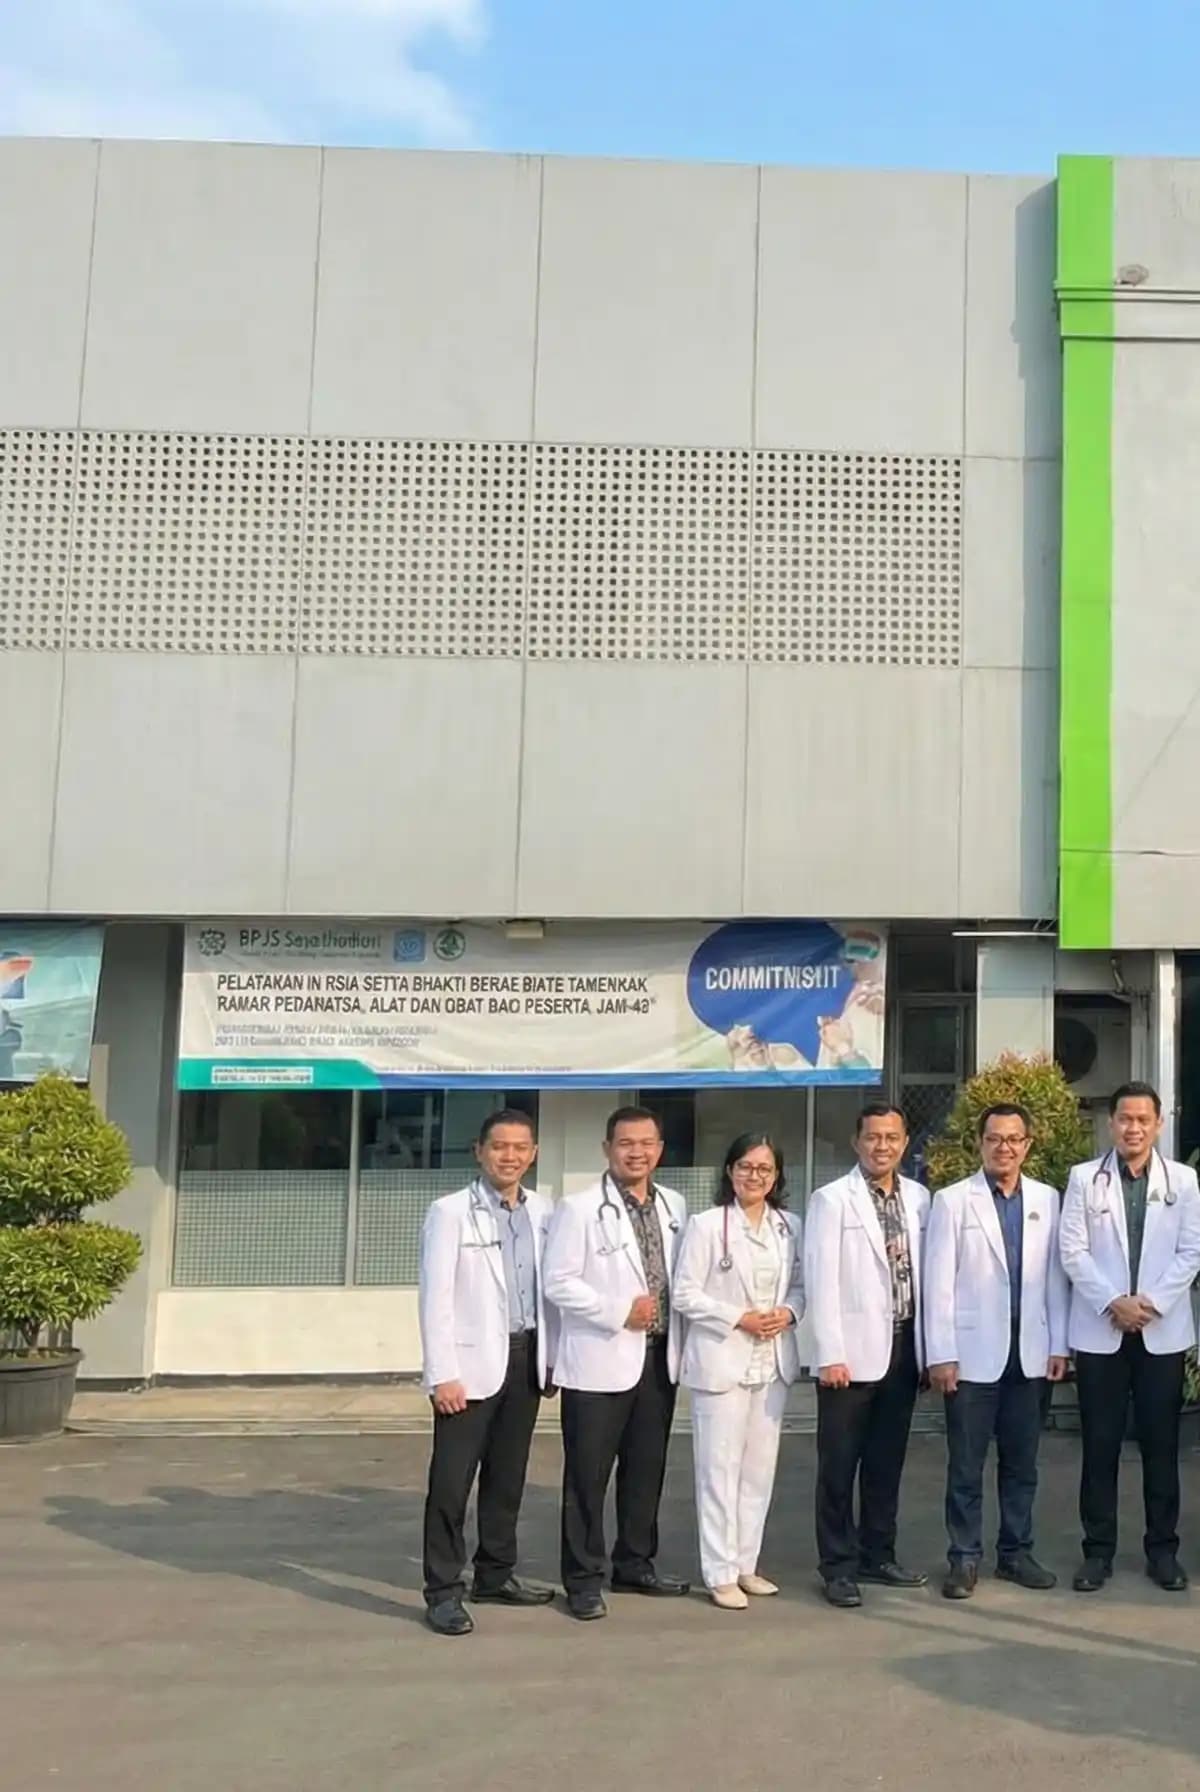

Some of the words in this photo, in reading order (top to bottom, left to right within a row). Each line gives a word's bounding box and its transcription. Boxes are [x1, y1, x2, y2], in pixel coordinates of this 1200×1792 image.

[239, 929, 280, 948] BPJS
[216, 974, 304, 991] PELATAKAN
[307, 975, 321, 991] IN
[325, 975, 359, 992] RSIA
[412, 975, 466, 992] BHAKTI
[470, 976, 519, 992] BERAE
[568, 977, 648, 993] TAMENKAK
[216, 995, 271, 1012] RAMAR
[369, 997, 407, 1013] ALAT
[410, 997, 441, 1013] DAN
[445, 998, 484, 1013] OBAT
[524, 998, 591, 1014] PESERTA
